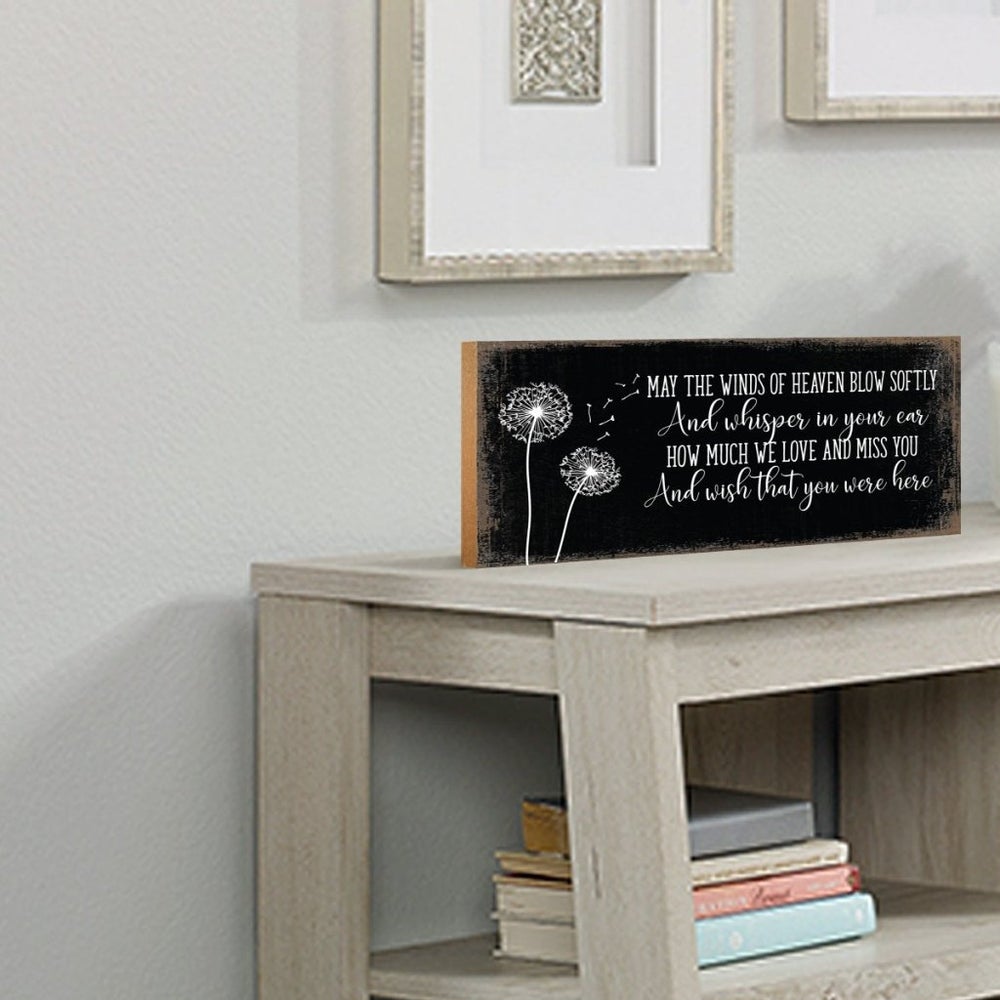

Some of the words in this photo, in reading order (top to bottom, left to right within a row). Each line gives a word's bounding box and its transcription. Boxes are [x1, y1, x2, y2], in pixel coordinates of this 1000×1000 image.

[647, 375, 678, 398] MAY
[684, 374, 714, 397] THE
[720, 373, 765, 396] WINDS
[770, 372, 787, 395] OF
[791, 371, 845, 394] HEAVEN
[849, 370, 885, 393] BLOW
[890, 369, 938, 392] SOFTLY
[657, 398, 724, 437] And
[725, 397, 811, 444] whisper
[816, 411, 839, 427] in
[838, 410, 891, 442] your
[896, 409, 929, 426] ear
[666, 444, 700, 468] HOW
[706, 442, 748, 466] MUCH
[754, 441, 777, 464] WE
[782, 439, 817, 463] LOVE
[822, 438, 852, 460] AND
[856, 436, 888, 459] MISS
[892, 435, 919, 457] YOU
[643, 468, 705, 508] And
[706, 466, 752, 503] wish
[749, 465, 804, 501] that
[798, 480, 839, 512] you
[844, 476, 887, 494] were
[892, 459, 933, 491] here
